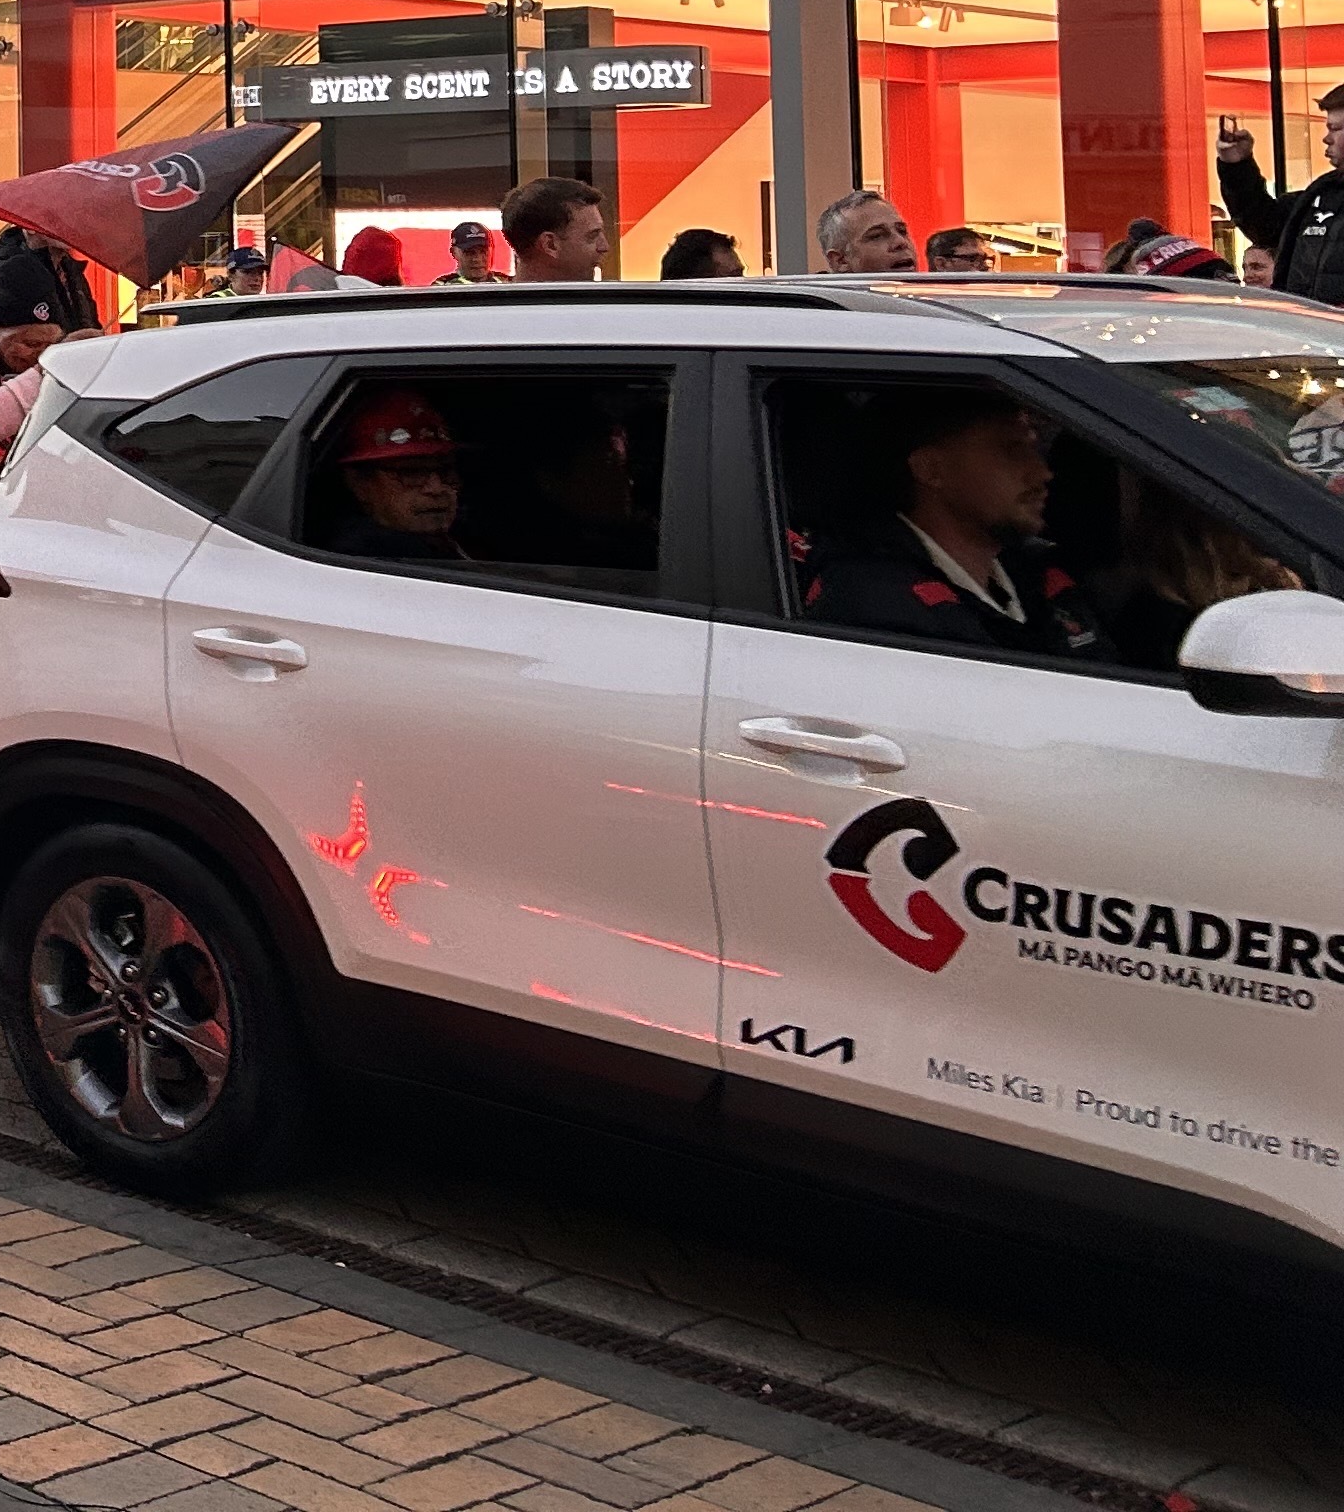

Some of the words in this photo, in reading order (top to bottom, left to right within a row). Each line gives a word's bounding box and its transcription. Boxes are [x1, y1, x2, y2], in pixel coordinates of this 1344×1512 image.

[310, 76, 392, 105] EVERY
[404, 70, 490, 101] SCENT
[508, 67, 544, 97] IS
[555, 68, 579, 94] A
[591, 60, 696, 92] STORY
[964, 867, 1344, 984] CRUSADERS
[1064, 947, 1156, 982] PANGO
[1208, 972, 1316, 1010] WHERO
[926, 1057, 995, 1094] Miles
[1001, 1073, 1045, 1104] Kia
[1075, 1088, 1162, 1129] Proud
[1169, 1111, 1200, 1138] to
[1207, 1119, 1283, 1156] drive
[1290, 1136, 1340, 1168] the
